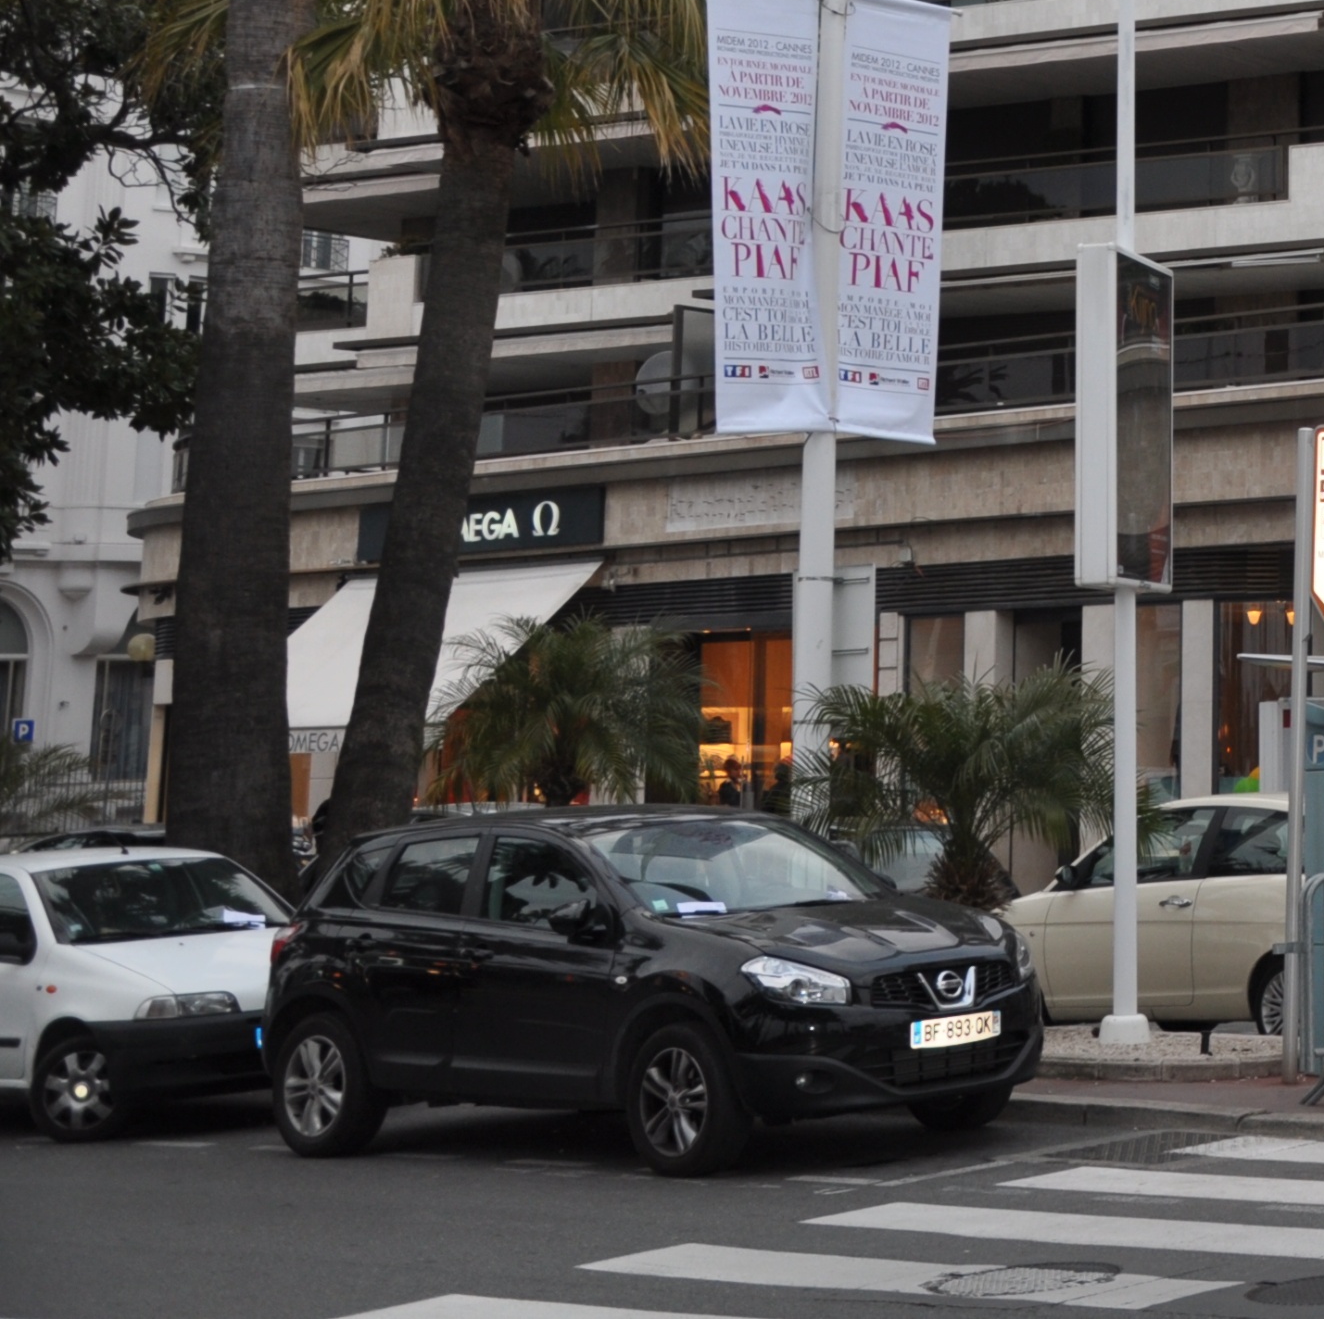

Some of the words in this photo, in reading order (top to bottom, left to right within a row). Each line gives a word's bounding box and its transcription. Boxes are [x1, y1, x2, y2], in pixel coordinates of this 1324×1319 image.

[717, 35, 745, 47] MIDEM
[748, 39, 769, 50] 2012
[776, 42, 812, 54] CANNES
[770, 62, 813, 74] MONDIALE
[851, 52, 878, 65] MIDEM
[881, 57, 901, 70] 2012
[906, 63, 940, 78] CANNES
[740, 71, 783, 87] PARTIR
[786, 76, 805, 89] DE
[718, 84, 787, 102] NOVEMBRE
[790, 92, 812, 106] 2012
[871, 88, 911, 107] PARTIR
[914, 96, 931, 110] DE
[849, 99, 914, 122] NOVEMBRE
[917, 112, 939, 127] 2012
[737, 117, 759, 132] VIE
[760, 119, 778, 134] EN
[780, 121, 811, 137] ROSE
[866, 131, 886, 148] VIE
[888, 135, 903, 150] EN
[905, 139, 938, 157] ROSE
[720, 176, 807, 217] KAAS
[843, 187, 934, 233] KAAS
[721, 215, 806, 245] CHANTE
[839, 225, 934, 260] CHANTE
[731, 242, 801, 280] PIAF
[847, 252, 925, 293] PIAF
[724, 323, 749, 341] LA
[757, 323, 815, 343] BELLE
[879, 317, 901, 334] TOI
[724, 341, 773, 353] HISTOIRE
[838, 328, 861, 347] LA
[871, 332, 931, 355] BELLE
[461, 508, 519, 542] EGA
[18, 723, 30, 740] P
